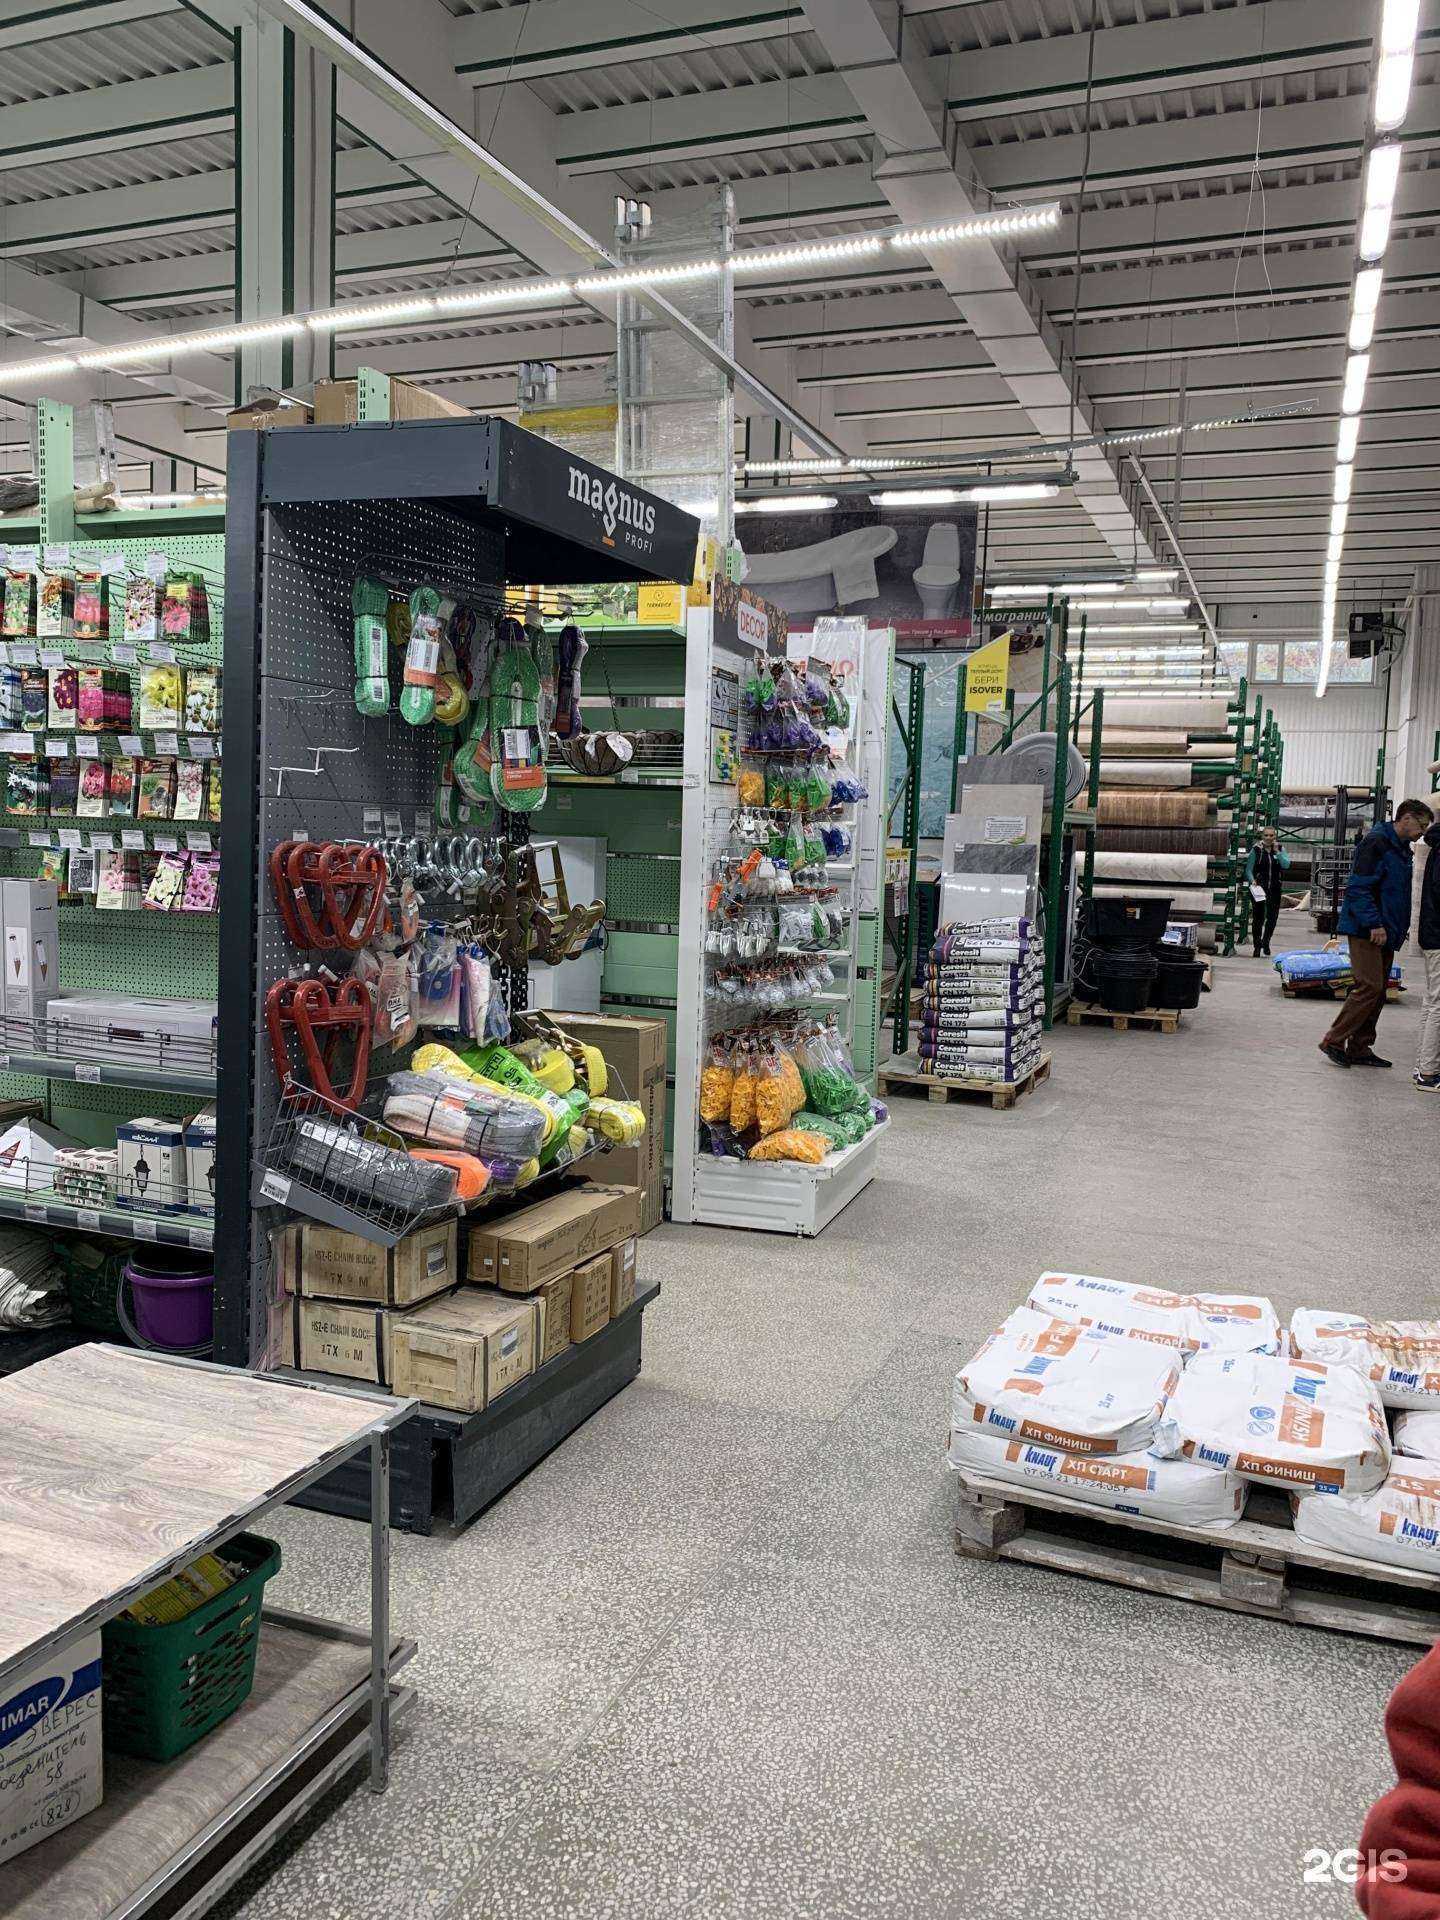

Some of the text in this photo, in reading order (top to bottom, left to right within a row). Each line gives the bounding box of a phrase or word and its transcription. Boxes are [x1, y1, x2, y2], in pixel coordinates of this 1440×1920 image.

[568, 466, 656, 537] magnus
[626, 532, 653, 554] PROFI
[739, 611, 766, 641] DECOR
[974, 675, 999, 685] БЕРИ
[968, 686, 1004, 695] ISOVER
[950, 948, 979, 957] Ceresit
[940, 980, 970, 988] Ceresit
[940, 996, 970, 1004] Ceresit
[940, 1011, 969, 1019] Ceresit
[937, 1029, 967, 1038] Ceresit
[938, 1044, 967, 1053] Ceresit
[934, 1061, 965, 1071] Ceresit
[1075, 1278, 1126, 1296] KNAUF
[330, 1323, 350, 1337] CHAIN
[1096, 1320, 1126, 1337] KNAUF
[353, 1349, 363, 1362] M
[1388, 1367, 1420, 1389] KNAUF
[988, 1408, 1017, 1434] KNAUF
[1025, 1427, 1092, 1452] ХП ФИНИШ
[1024, 1446, 1058, 1472] KNAUF
[1199, 1443, 1231, 1468] KNAUF
[1067, 1459, 1128, 1480] ХП СТАРТ
[1241, 1460, 1316, 1482] ХП ФИНИШ
[1401, 1518, 1440, 1546] KNAUF
